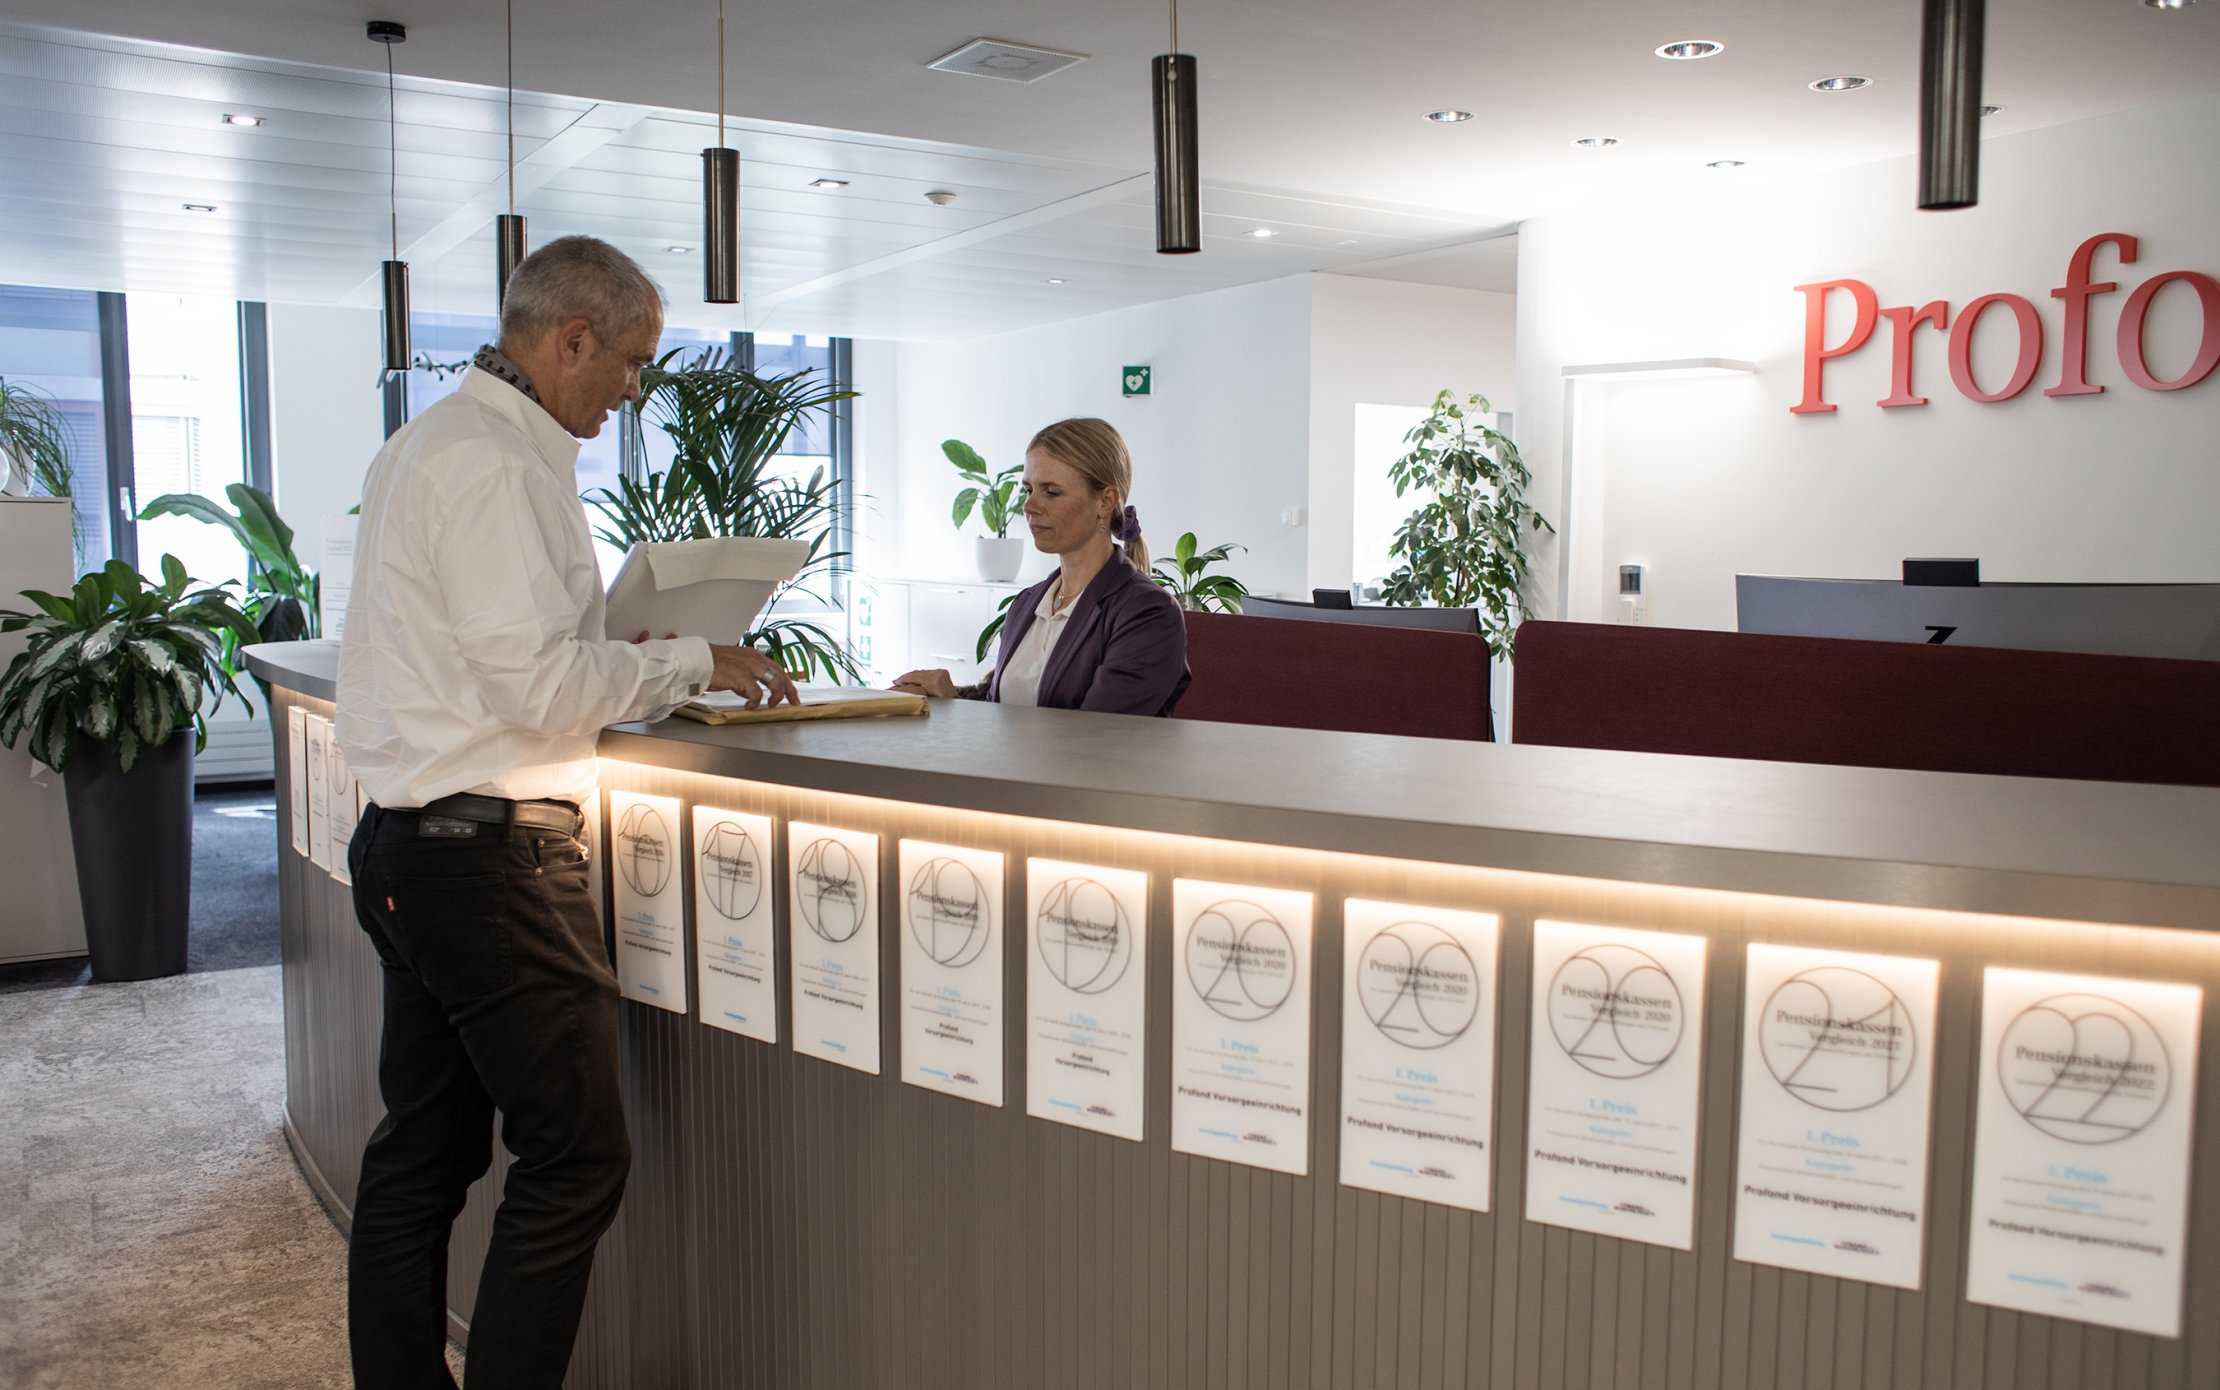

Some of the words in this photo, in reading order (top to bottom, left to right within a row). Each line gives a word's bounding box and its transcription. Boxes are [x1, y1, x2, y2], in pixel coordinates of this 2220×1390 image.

[1790, 232, 2220, 414] Profo
[1197, 936, 1286, 958] Pensionskassen
[1370, 959, 1469, 983] Pensionskassen
[1562, 983, 1672, 1010] Pensionskassen
[1776, 1009, 1902, 1036] Pensionskassen
[1231, 1040, 1259, 1055] Preis
[1407, 1068, 1438, 1084] Preis
[1178, 1086, 1211, 1100] Profond
[1213, 1092, 1302, 1116] Vorsorgeeinrichtung
[1602, 1099, 1638, 1116] Preis
[1347, 1116, 1384, 1131] Profond
[1386, 1121, 1484, 1149] Vorsorgeeinrichtung
[1820, 1132, 1860, 1149] Preis
[1535, 1150, 1575, 1166] Profond
[1578, 1155, 1687, 1185] Vorsorgeeinrichtung
[1744, 1184, 1789, 1201] Profond
[1792, 1191, 1916, 1222] Vorsorgeeinrichtung
